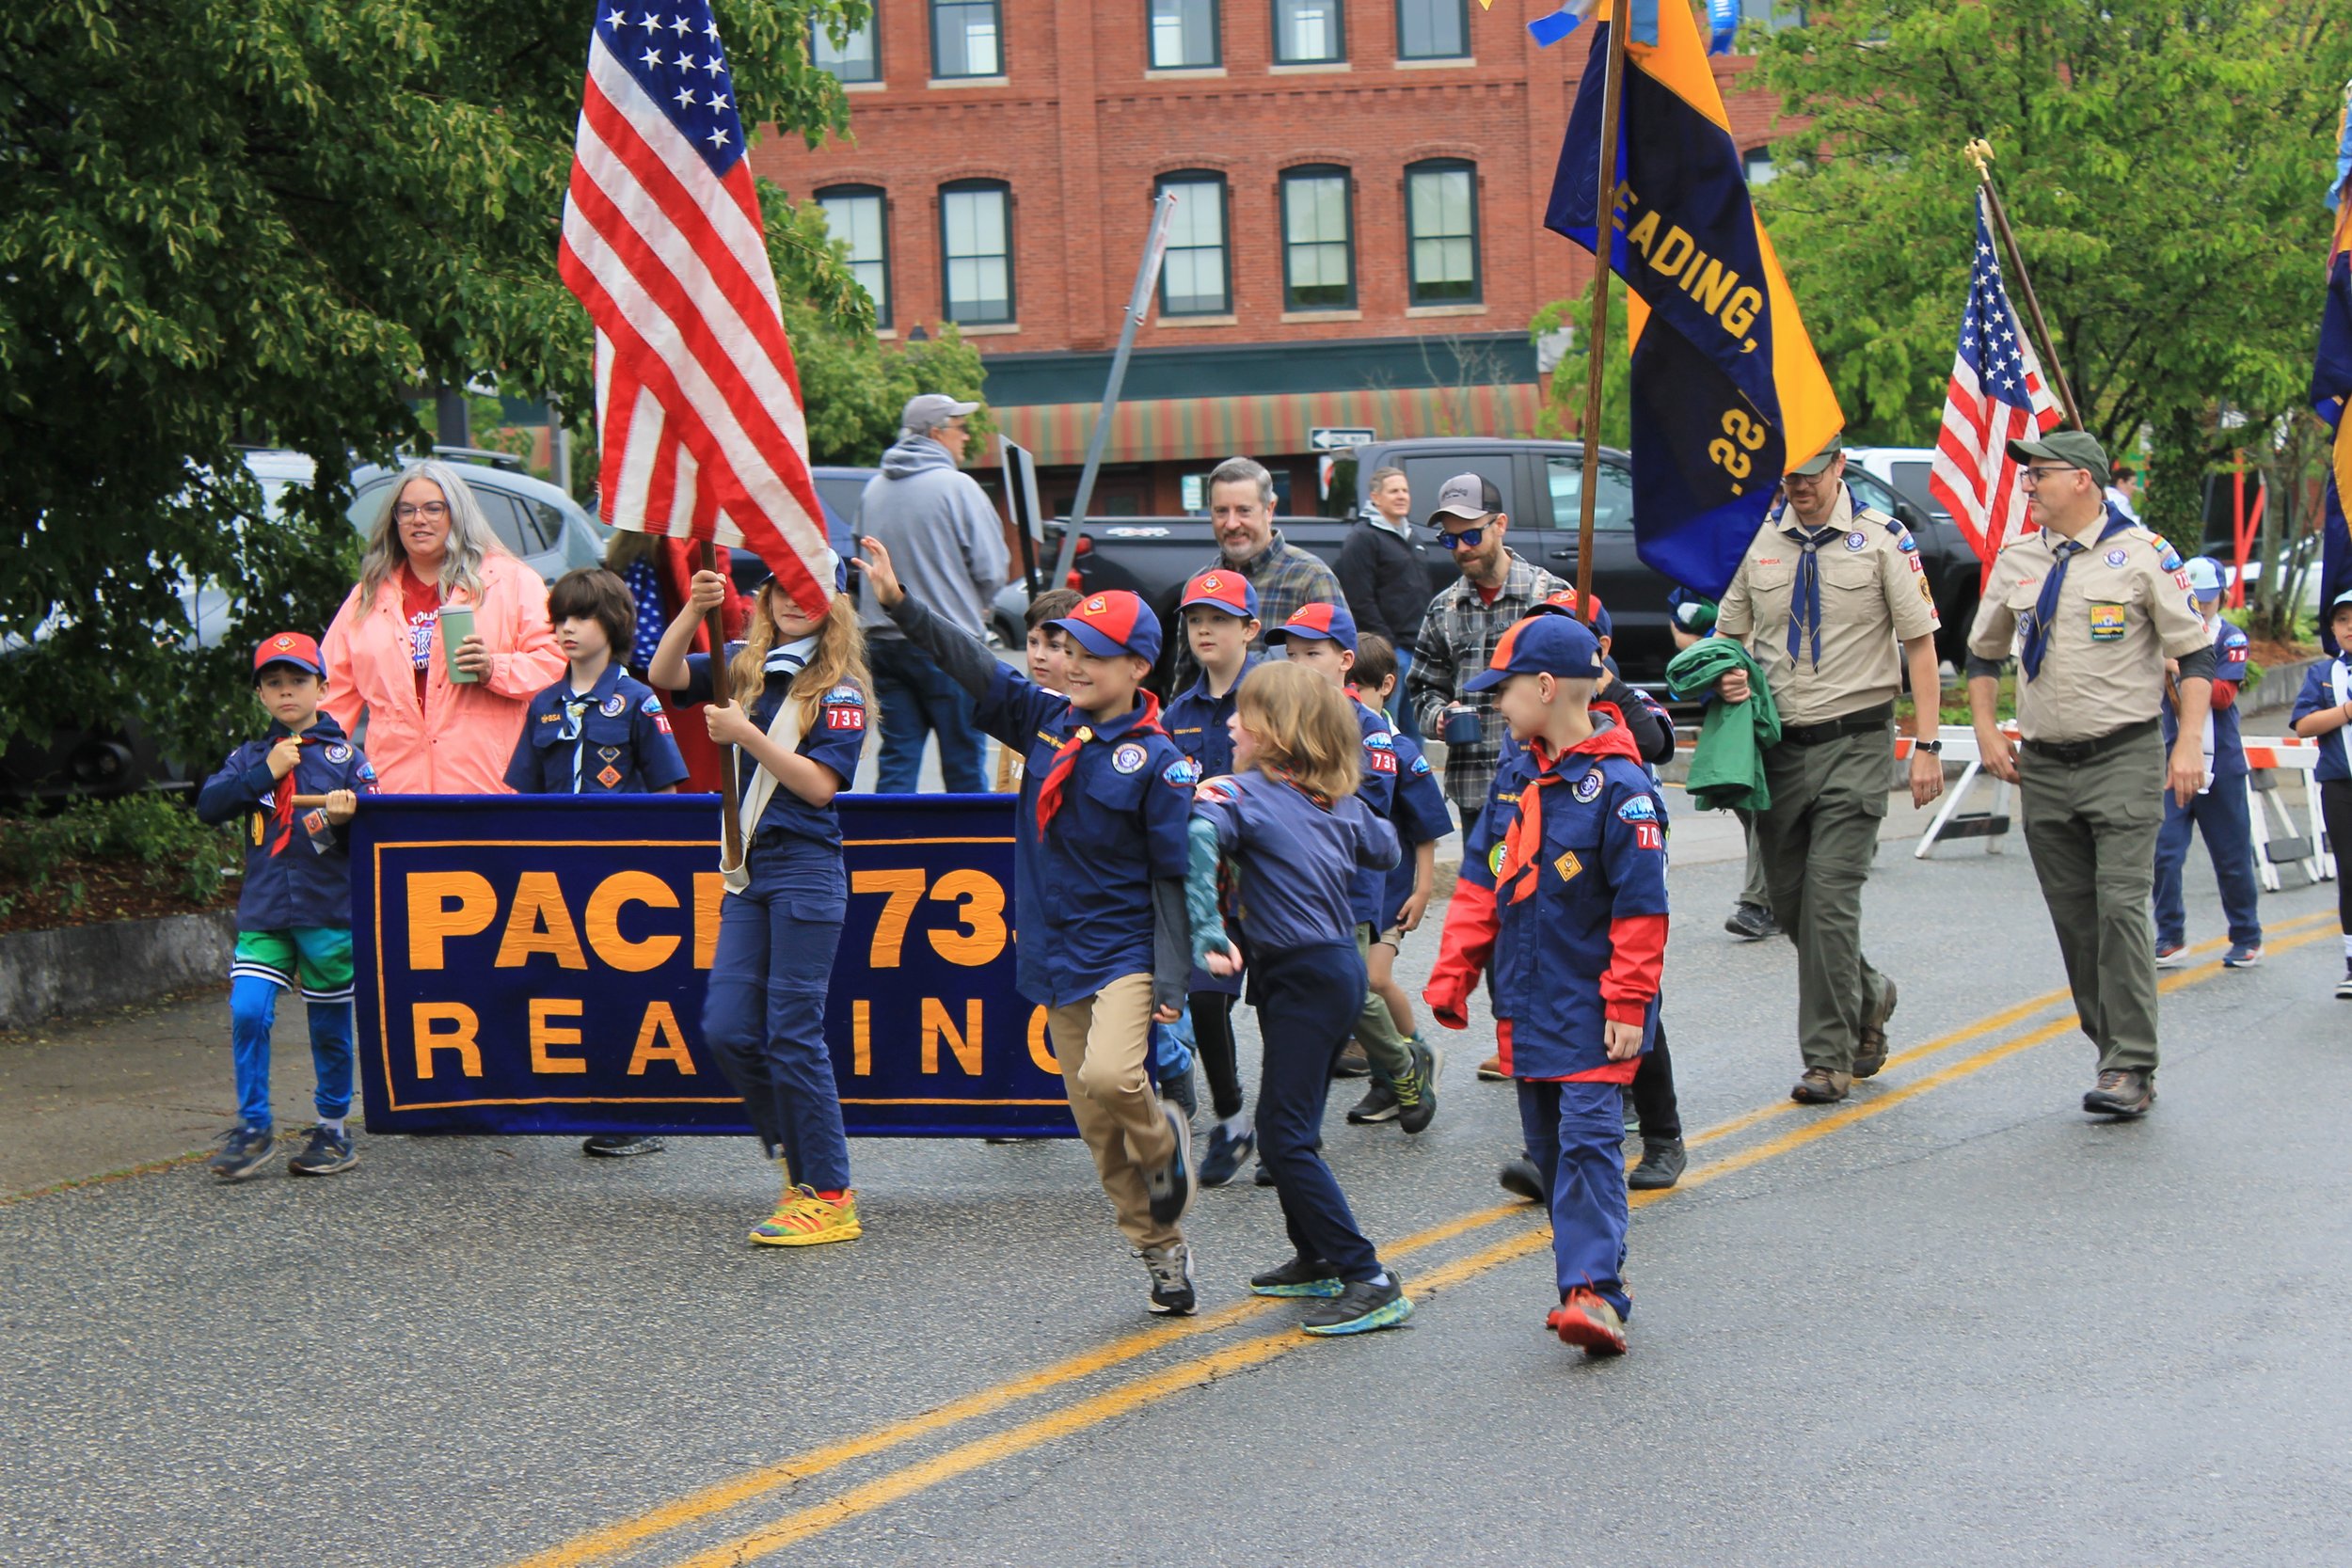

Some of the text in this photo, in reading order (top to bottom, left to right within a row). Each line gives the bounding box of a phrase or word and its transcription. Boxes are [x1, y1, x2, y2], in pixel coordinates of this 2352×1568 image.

[1613, 180, 1762, 354] EADING,
[829, 710, 862, 727] 733
[1374, 753, 1397, 771] 733
[1639, 827, 1662, 848] 70
[850, 868, 1016, 969] 73
[412, 998, 1063, 1080] REAIN
